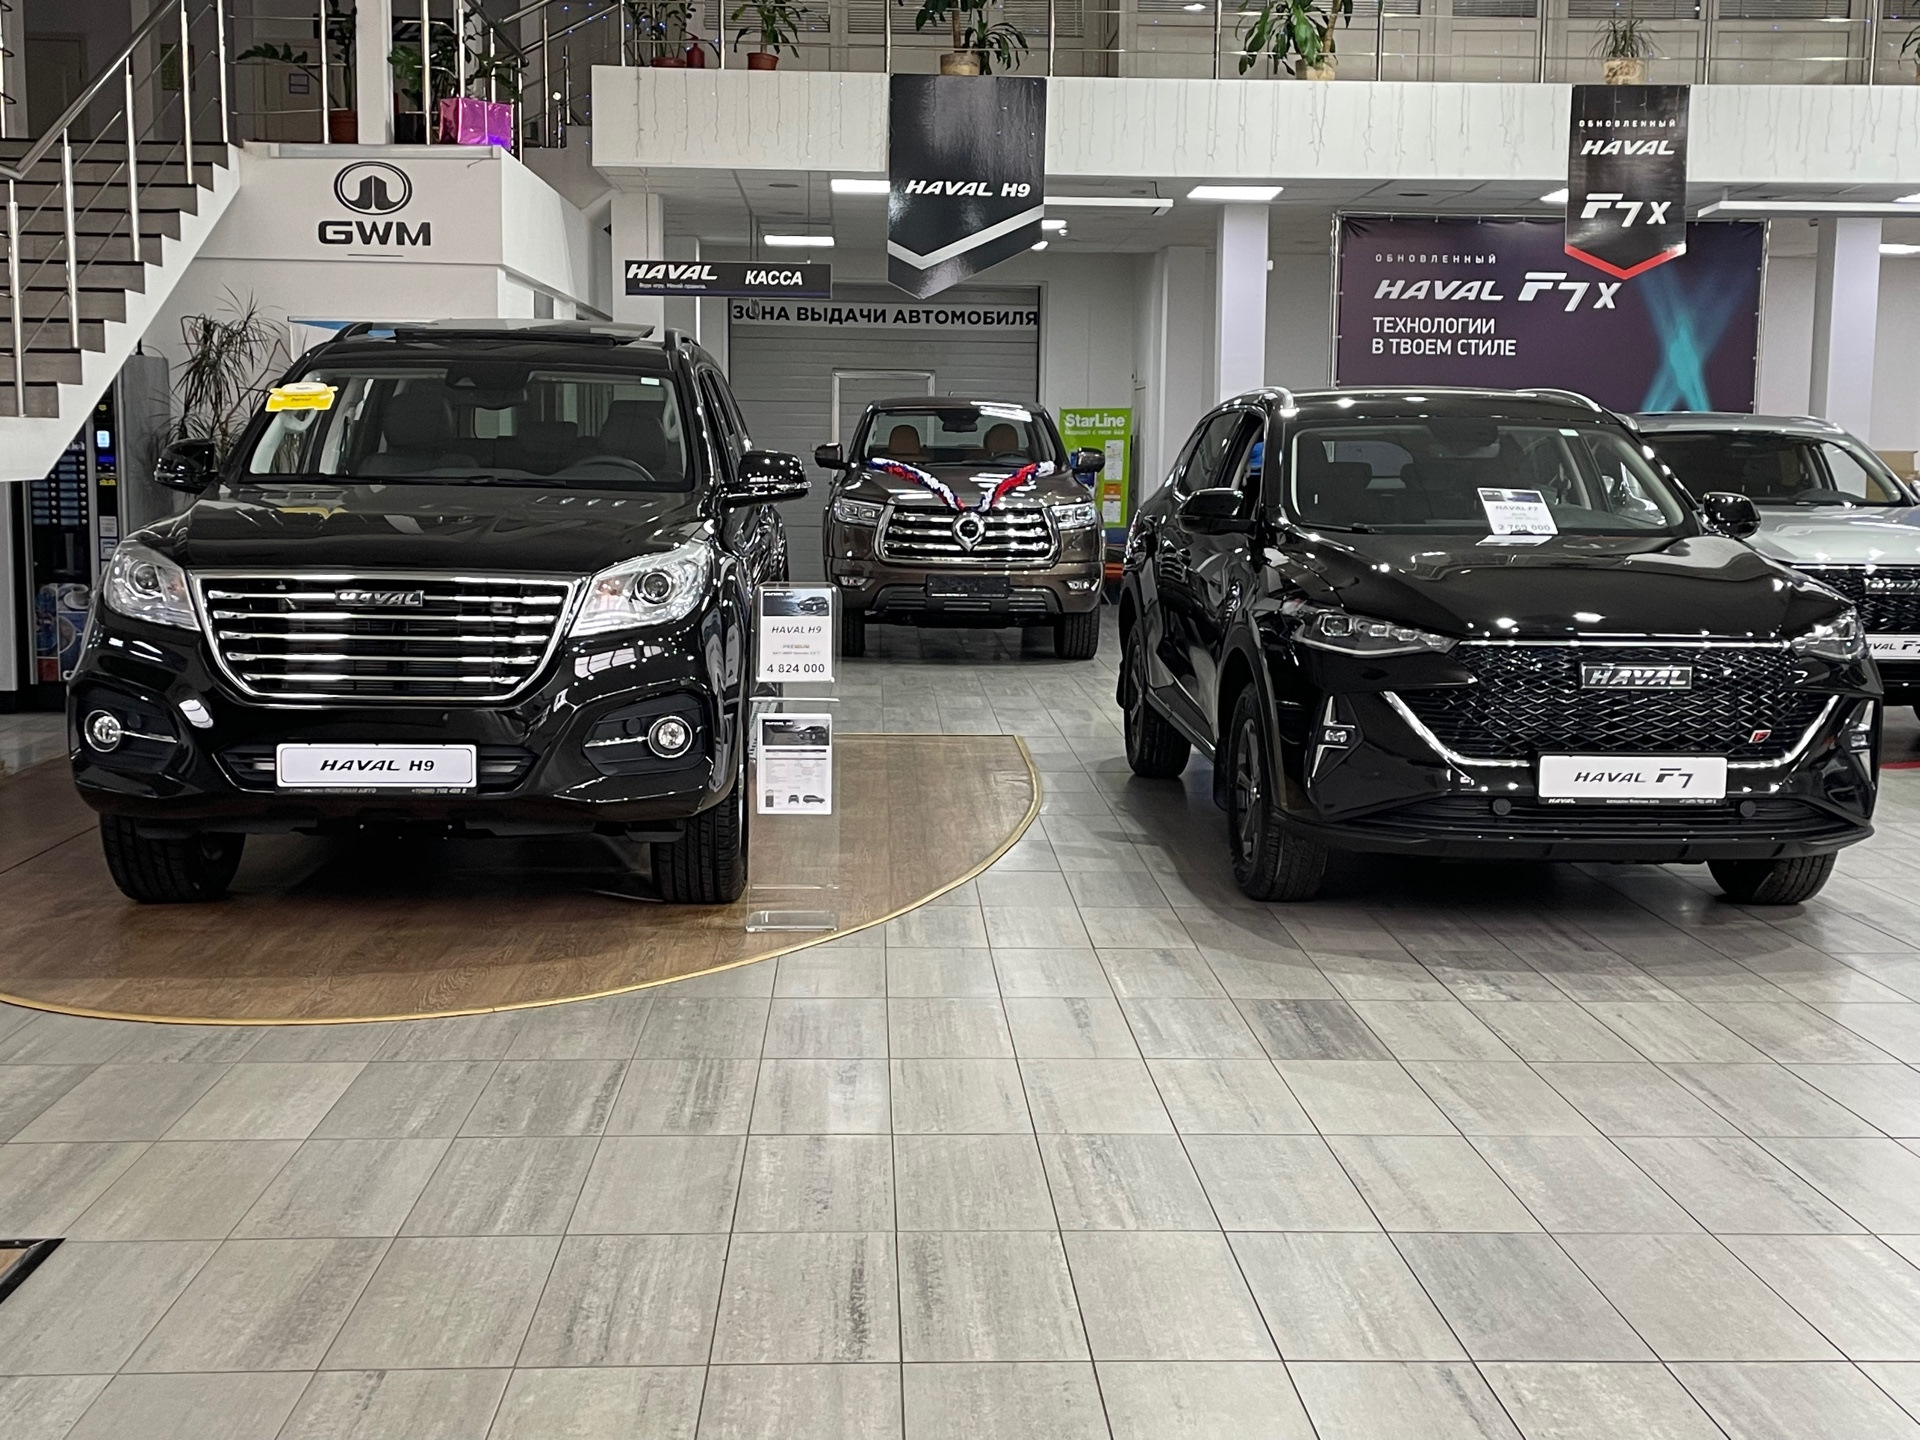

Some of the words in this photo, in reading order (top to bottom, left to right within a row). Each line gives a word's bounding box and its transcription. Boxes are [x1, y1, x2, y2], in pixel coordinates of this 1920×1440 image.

[1579, 119, 1676, 127] ОБНОВЛЕННЫЙ
[1580, 140, 1675, 155] HAVAL
[904, 180, 994, 196] HAVAL
[1000, 183, 1031, 197] H9
[318, 221, 431, 246] GWM
[1375, 254, 1496, 264] ОБНОВЛЕННЫЙ
[627, 264, 718, 280] HAVAL
[744, 270, 803, 286] КАССА
[1374, 280, 1504, 300] HAVAL
[732, 305, 790, 321] ЗОНА
[797, 307, 887, 324] ВЫДАЧИ
[893, 309, 1038, 326] АВТОМОБИЛЯ
[1373, 316, 1495, 334] ТЕХНОЛОГИИ
[1372, 338, 1384, 354] В
[1389, 339, 1452, 355] ТВОЕМ
[1457, 339, 1517, 356] СТИЛЕ
[1065, 413, 1126, 427] StarLine
[340, 593, 419, 604] HAVAL
[771, 626, 804, 634] HAVAL
[808, 626, 822, 634] H9
[766, 664, 774, 673] 4
[778, 664, 800, 673] 824
[803, 664, 825, 673] 000
[1589, 670, 1686, 684] HAVAL
[320, 760, 400, 771] HAVAL
[408, 760, 435, 771] H9
[1574, 772, 1646, 783] HAVAL
[1655, 768, 1694, 789] F7
